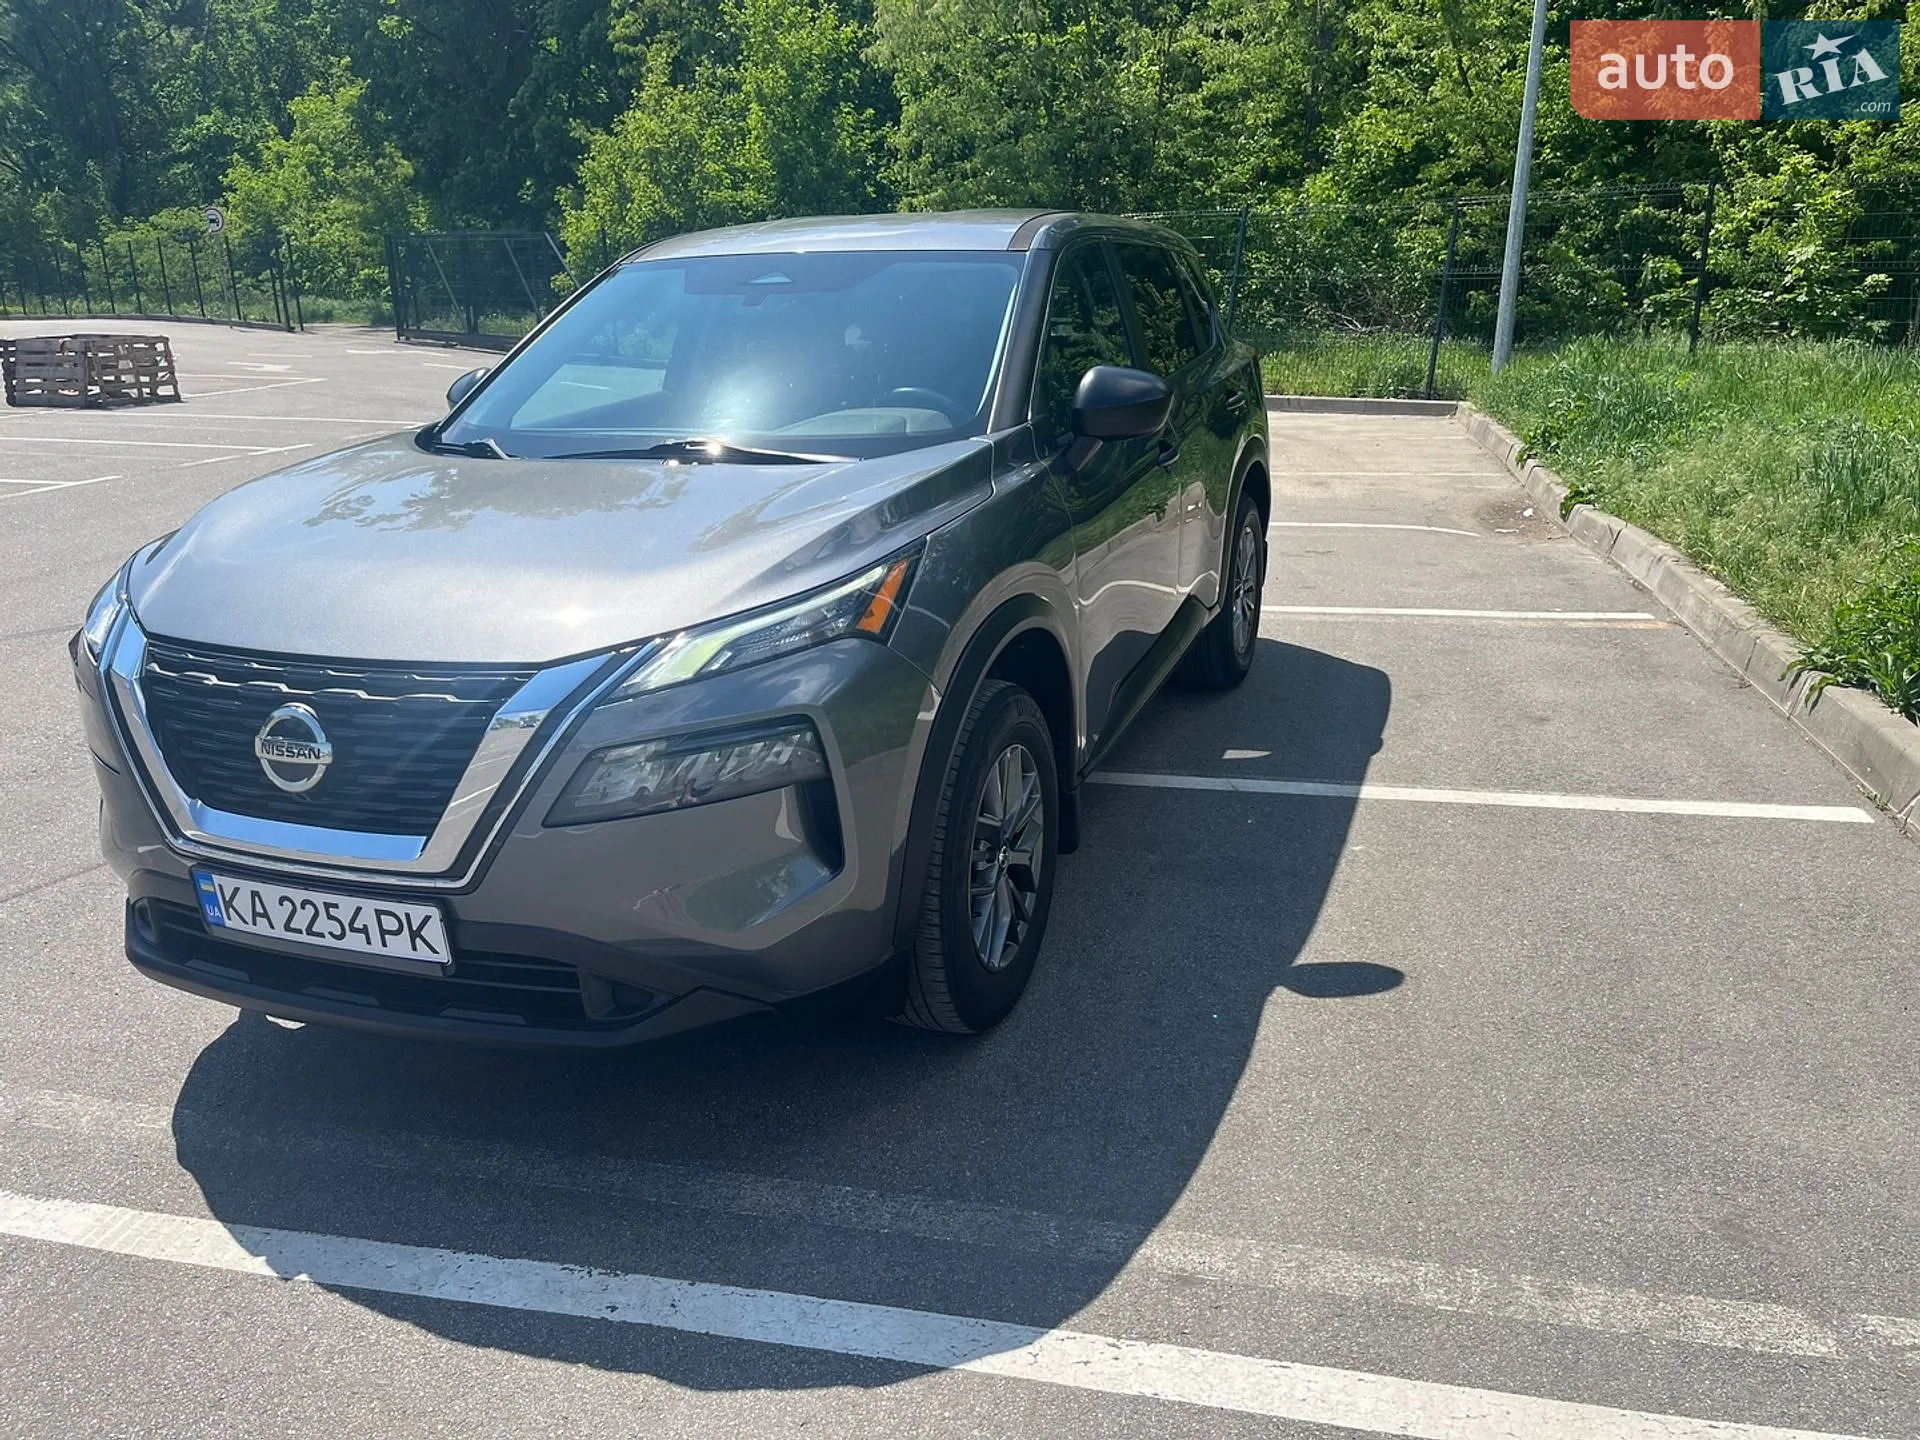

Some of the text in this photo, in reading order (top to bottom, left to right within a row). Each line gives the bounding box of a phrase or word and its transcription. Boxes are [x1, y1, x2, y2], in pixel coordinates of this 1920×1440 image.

[261, 742, 321, 760] NISSAN
[206, 905, 223, 919] UA
[218, 883, 440, 955] KA 2254 PK
